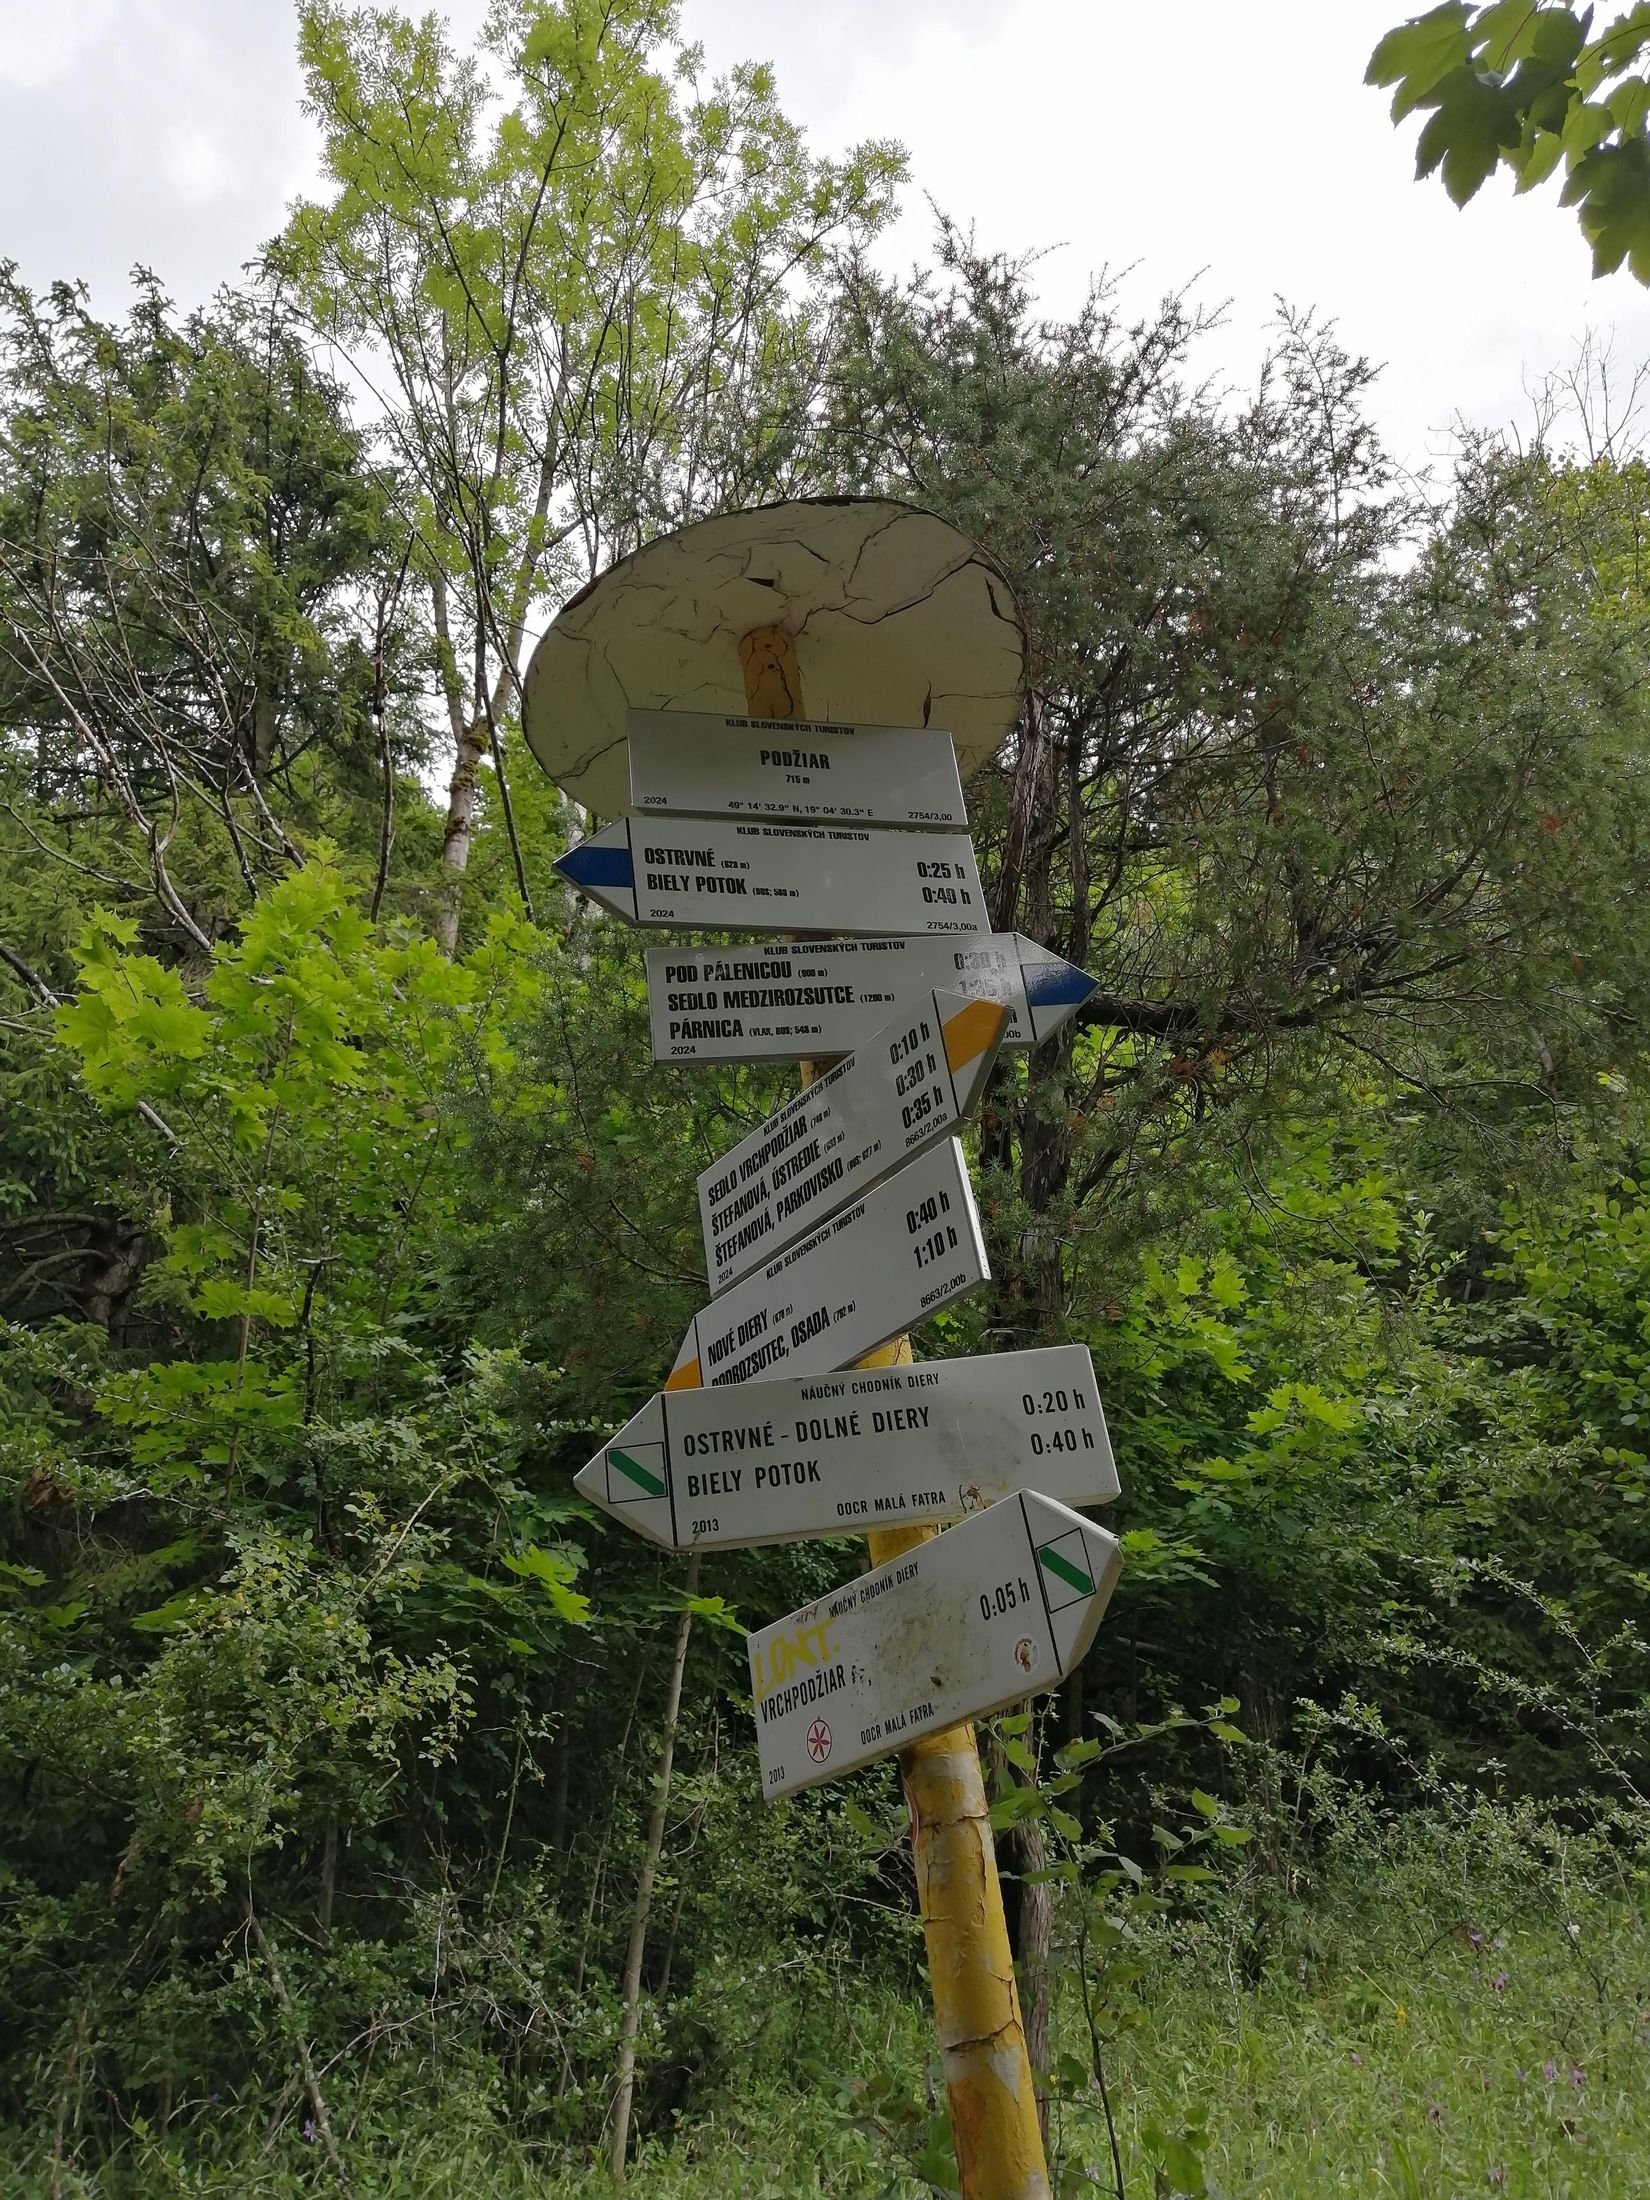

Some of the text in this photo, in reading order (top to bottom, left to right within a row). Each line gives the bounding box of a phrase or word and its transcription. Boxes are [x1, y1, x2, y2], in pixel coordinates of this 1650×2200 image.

[725, 718, 855, 735] KLUB SLOVENSKÝCH TURISTOV
[760, 749, 831, 769] PODŽIAR
[785, 774, 801, 784] 715
[643, 796, 668, 805] 2024
[728, 801, 744, 809] 49°
[792, 805, 803, 815] N,
[867, 809, 874, 817] E
[908, 811, 953, 821] 2754/3,00
[736, 826, 870, 841] KLUB SLOVENSKÝCH TURISTOV
[644, 848, 716, 868] OSTRVNÉ
[739, 861, 750, 870] m)
[916, 861, 966, 879] 0:25 h
[646, 873, 690, 891] BIELY
[695, 876, 748, 895] POTOK
[789, 889, 800, 898] m)
[921, 886, 971, 905] 0:40 h
[650, 909, 675, 918] 2024
[926, 921, 978, 931] 2754/3,00a
[763, 941, 906, 956] KLUB SLOVENSKÝCH TURISTOV
[665, 965, 698, 984] POD
[703, 960, 792, 982] PÁLENICOU
[817, 968, 828, 978] m)
[667, 991, 718, 1012] SEDLO
[723, 985, 855, 1009] MEDZIROZSUTCE
[884, 992, 895, 1002] m)
[669, 1018, 822, 1040] PÁRNICA (VLAK, BUS; 548 m)
[889, 1021, 930, 1065] 0:10 h
[670, 1045, 696, 1055] 2024
[895, 1053, 937, 1097] 0:30 h
[763, 1056, 856, 1137] KLUB SLOVENSKÝCH TURISTOV
[901, 1085, 944, 1129] 0:35 h
[905, 1112, 948, 1148] 8663/2,00a
[708, 1169, 738, 1207] SEDLO
[738, 1115, 808, 1182] VRCHPODŽIAR
[711, 1176, 771, 1237] ŠTEFANOVÁ,
[771, 1137, 821, 1191] ÚSTREDIE
[715, 1206, 775, 1267] ŠTEFANOVÁ,
[776, 1156, 844, 1223] PARKOVISKO
[906, 1190, 951, 1235] 0:40 h
[765, 1203, 866, 1280] KLUB SLOVENSKÝCH TURISTOV
[913, 1225, 958, 1269] 1:10 h
[717, 1267, 733, 1284] 2024
[920, 1273, 967, 1308] 8663/2,00b
[707, 1328, 736, 1367] NOVÉ
[737, 1308, 768, 1347] DIERY
[790, 1306, 831, 1349] OSADA
[801, 1372, 940, 1400] NÁUČNÝ CHODNÍK DIERY
[1022, 1388, 1086, 1416] 0:20 h
[683, 1421, 775, 1457] OSTRVNÉ
[795, 1410, 861, 1443] DOLNÉ
[872, 1406, 930, 1434] DIERY
[1030, 1428, 1095, 1456] 0:40 h
[687, 1459, 821, 1497] BIELY POTOK
[836, 1490, 946, 1516] OOCR MALÁ FATRA
[692, 1518, 719, 1534] 2013
[859, 1574, 894, 1603] CHODNÍK
[896, 1560, 919, 1585] DIERY
[980, 1577, 1030, 1621] 0:05 h
[760, 1664, 846, 1724] VRCHPODŽIAR
[860, 1702, 934, 1745] OOCR MALÁ FATRA
[768, 1765, 786, 1785] 2013
